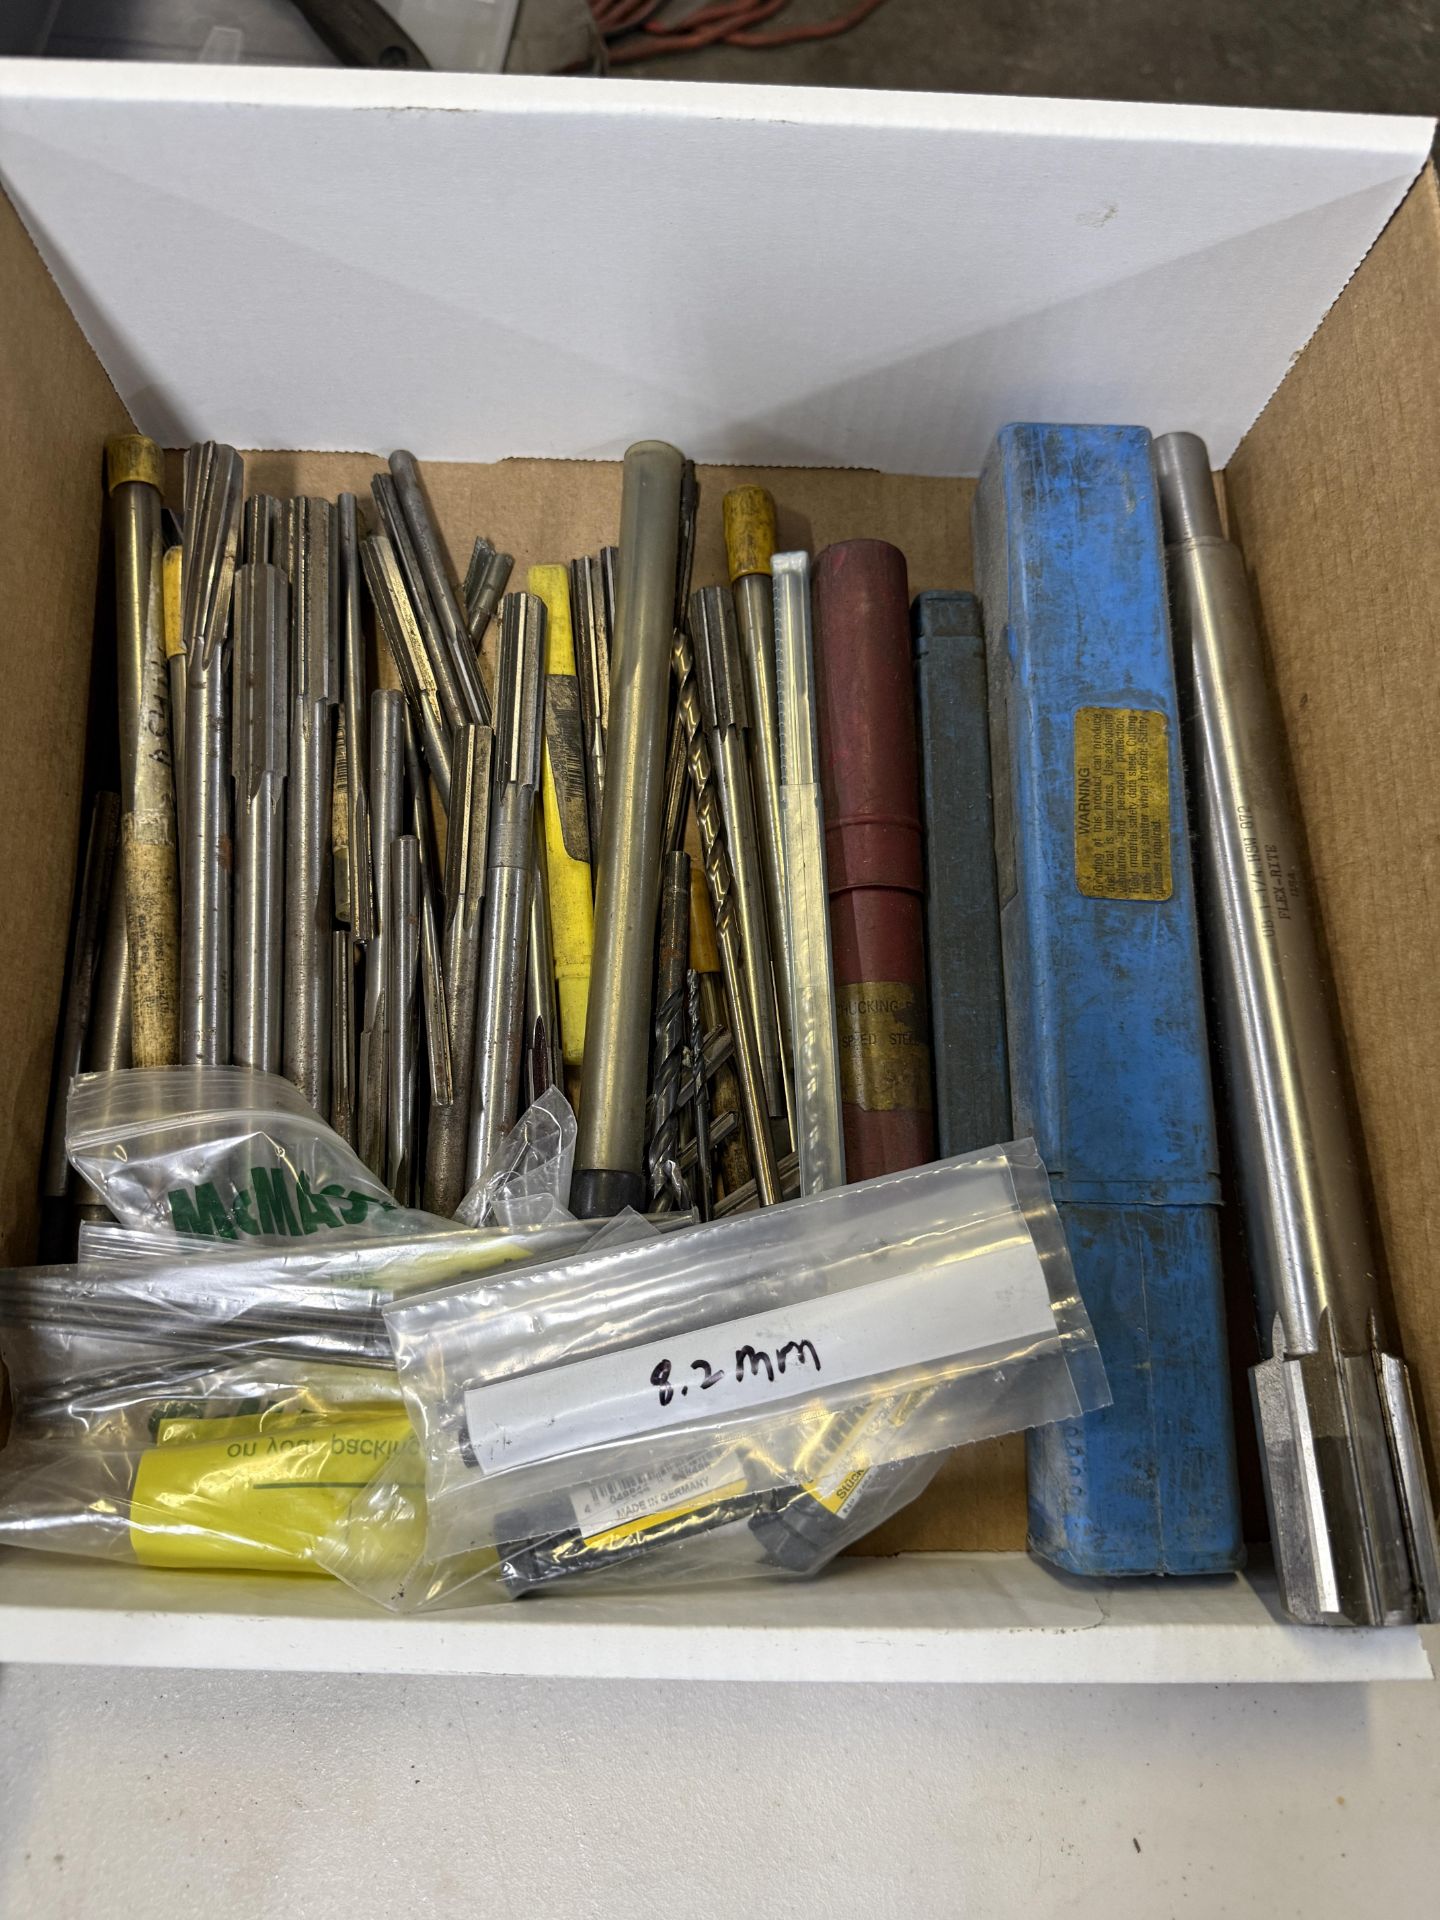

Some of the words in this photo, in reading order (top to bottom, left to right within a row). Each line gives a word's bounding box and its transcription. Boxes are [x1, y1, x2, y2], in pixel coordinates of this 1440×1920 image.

[1091, 714, 1103, 750] produce
[1116, 716, 1126, 762] protection.
[1093, 755, 1101, 770] can
[1104, 760, 1113, 775] Use
[1078, 767, 1090, 834] WARNING
[1092, 776, 1103, 810] product
[1116, 772, 1126, 810] personal
[1127, 780, 1136, 798] data
[1139, 786, 1148, 808] when
[1092, 816, 1102, 832] this
[1127, 802, 1138, 828] safety
[1117, 821, 1126, 837] and
[1139, 814, 1150, 845] shatter
[1104, 850, 1114, 867] that
[1128, 832, 1137, 867] material
[1141, 850, 1152, 867] may
[1265, 844, 1291, 920] FLEX-RITE
[838, 1001, 899, 1016] HUCKING
[616, 1500, 647, 1518] MADE
[648, 1494, 660, 1507] IN
[660, 1476, 710, 1502] GERMANY
